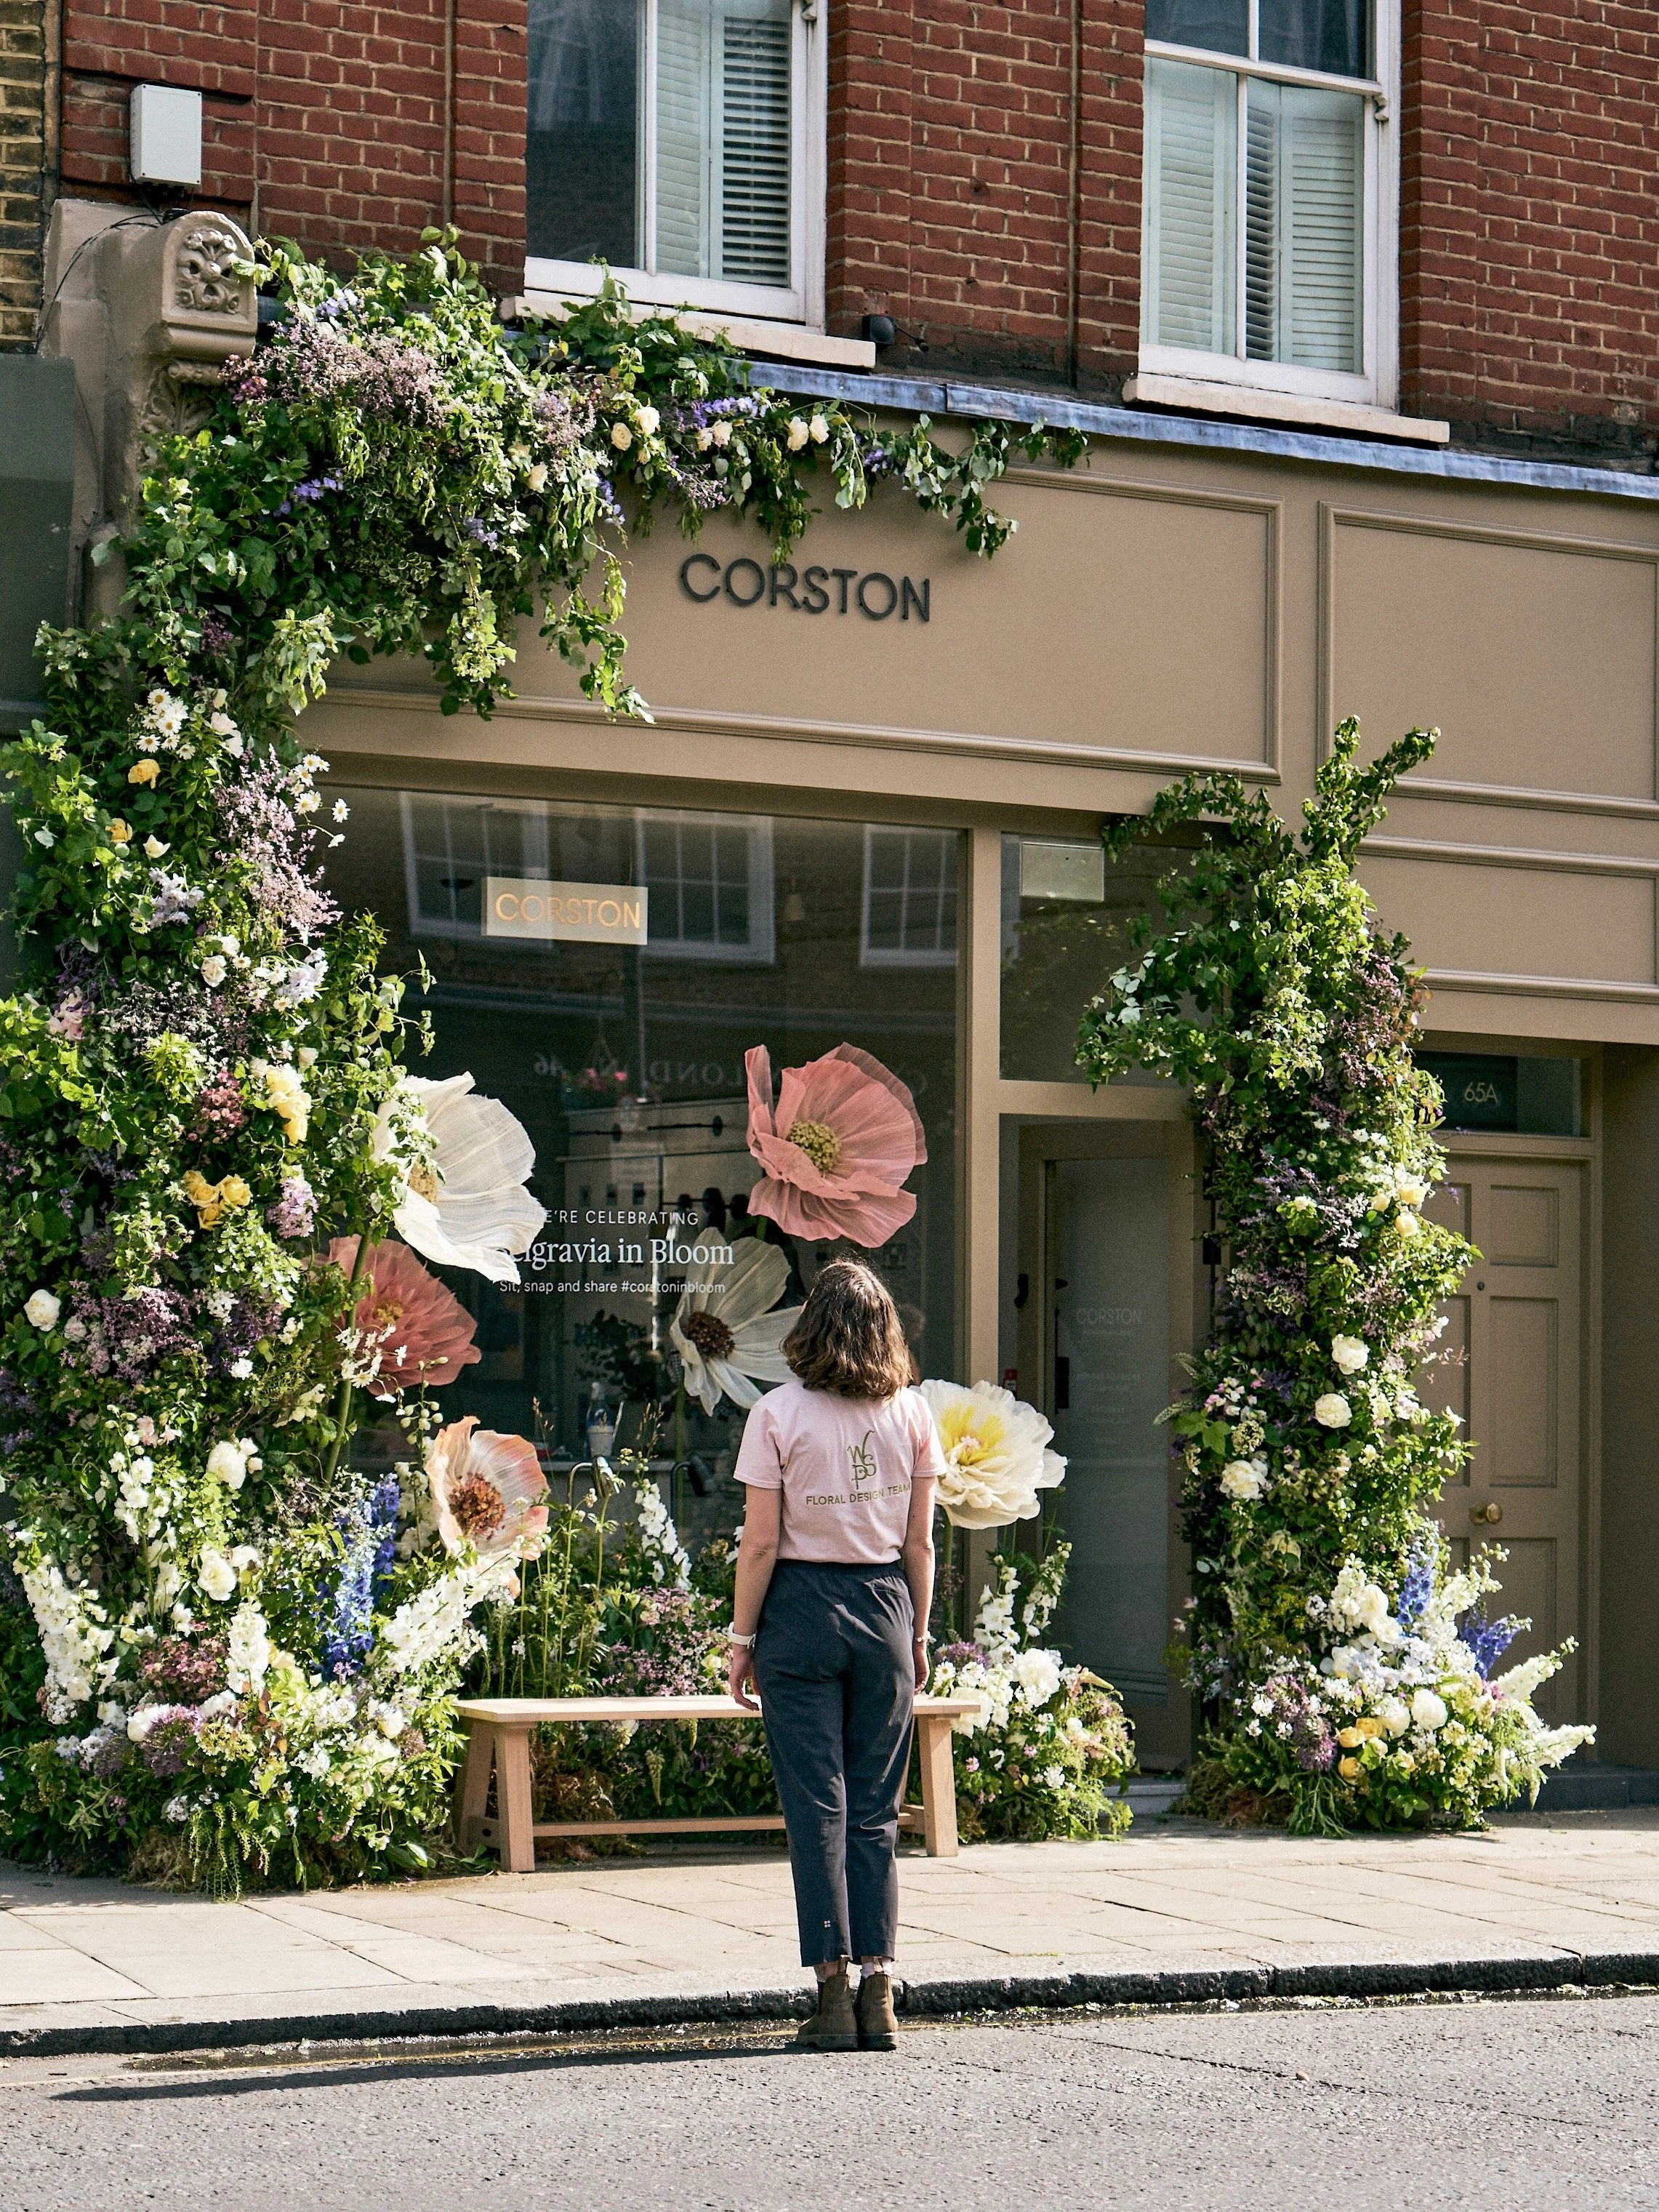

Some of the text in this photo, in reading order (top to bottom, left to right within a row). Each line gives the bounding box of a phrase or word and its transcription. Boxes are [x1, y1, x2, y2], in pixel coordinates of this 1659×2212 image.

[680, 553, 931, 622] CORSTON
[495, 893, 640, 929] CORSTON
[1463, 1081, 1499, 1105] 65A
[544, 1210, 699, 1225] E'RE CELEBRATING
[618, 1238, 643, 1264] in
[650, 1238, 735, 1265] Bloom
[524, 1282, 553, 1294] snap
[557, 1281, 580, 1292] and
[584, 1281, 618, 1293] share
[1076, 1307, 1142, 1325] CORSTON
[806, 1481, 911, 1505] FLORAL DESIGN TEAM
